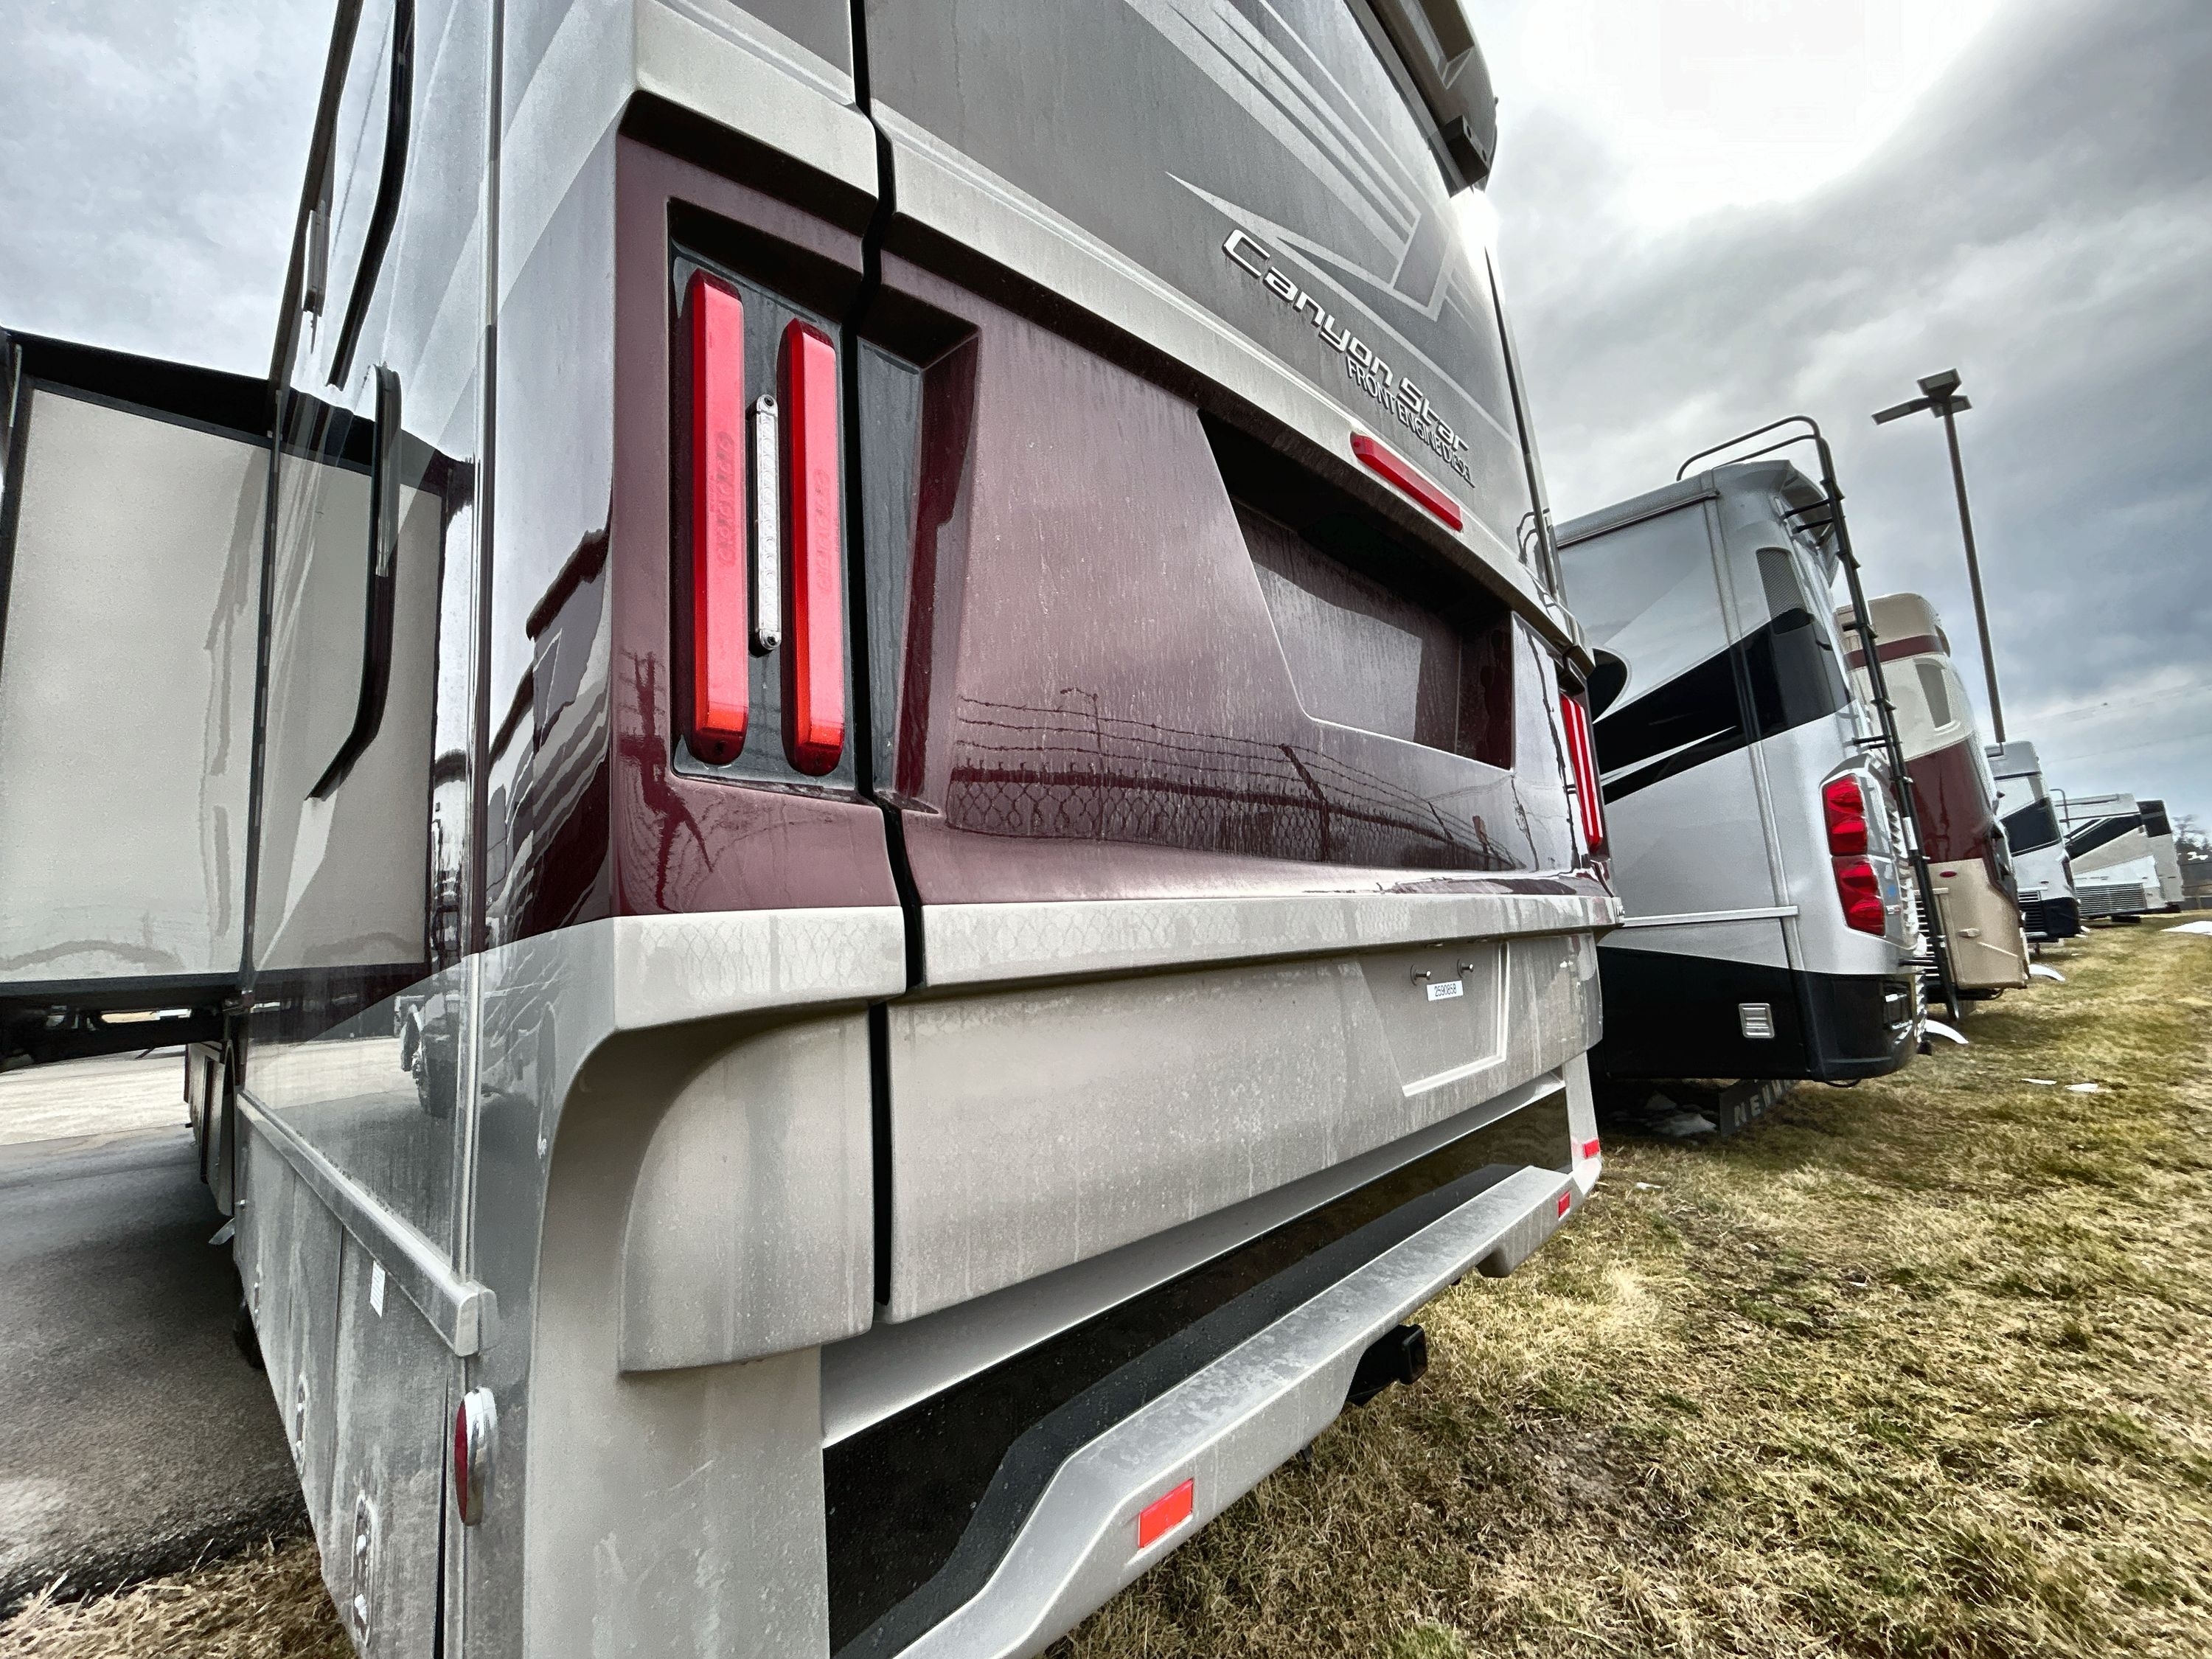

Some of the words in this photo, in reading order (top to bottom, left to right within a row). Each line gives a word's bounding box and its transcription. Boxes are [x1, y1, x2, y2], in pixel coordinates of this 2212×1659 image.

[1222, 229, 1394, 388] Canyon
[1396, 377, 1470, 451] Star
[1346, 355, 1397, 414] FRONT
[1396, 399, 1443, 457] ENGINE
